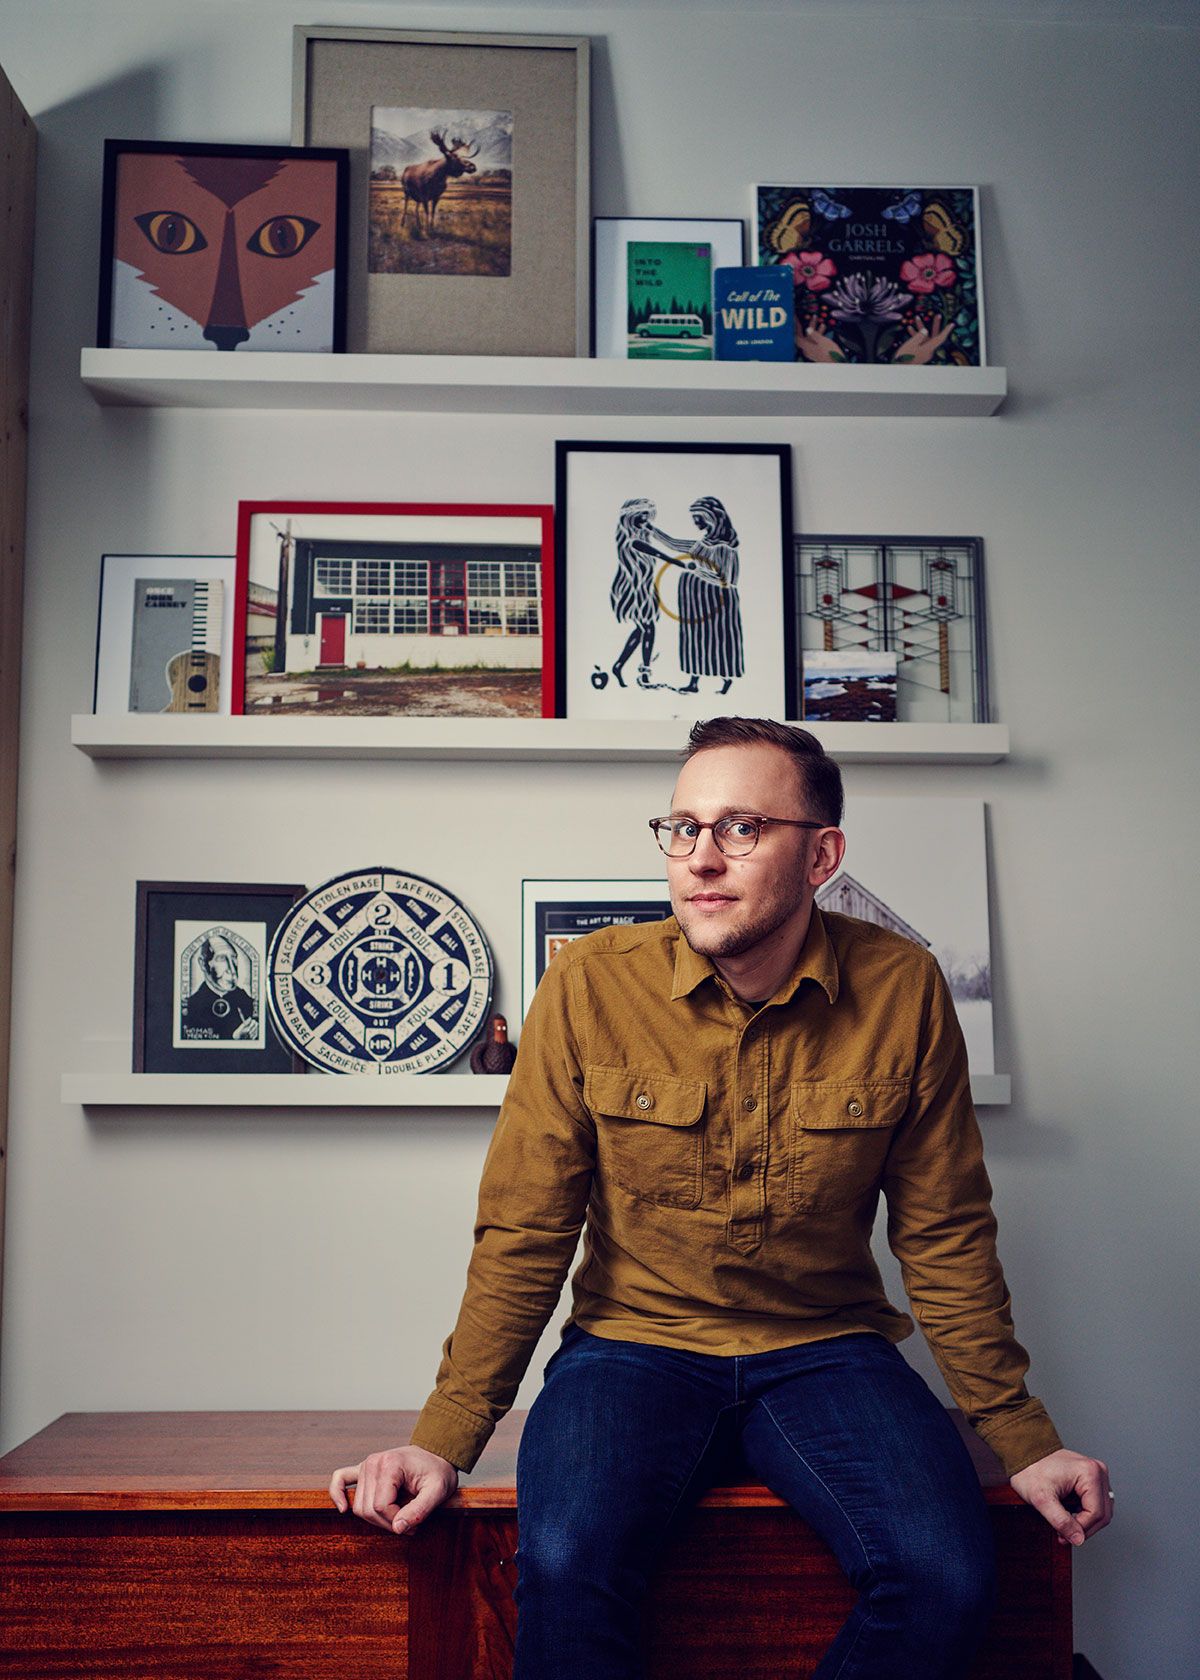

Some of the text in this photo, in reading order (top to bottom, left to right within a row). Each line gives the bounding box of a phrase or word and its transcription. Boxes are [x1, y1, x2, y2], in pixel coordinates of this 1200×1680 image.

[845, 223, 887, 237] JOSH
[828, 239, 905, 253] GARRELS
[634, 258, 662, 266] INTO
[635, 268, 657, 276] THE
[635, 279, 663, 287] WILD
[727, 289, 781, 302] Call of The
[721, 306, 787, 330] WILD
[314, 878, 379, 909] STOLEN BASE
[395, 881, 443, 904] SAFE HIT
[374, 904, 391, 926] 2
[589, 916, 601, 924] ART
[281, 915, 309, 964] SACRIFICE
[329, 928, 355, 952] FOUL
[406, 926, 432, 951] FOUL
[451, 911, 485, 974] STOLEN BASE
[376, 957, 387, 968] H
[309, 965, 325, 985] 3
[362, 970, 372, 982] H
[390, 971, 400, 982] H
[443, 963, 457, 991] 1
[376, 983, 387, 994] H
[278, 976, 310, 1040] STOLEN BASE
[326, 999, 352, 1025] FOUL
[407, 1004, 432, 1027] FOUL
[457, 990, 484, 1037] SAFE HIT
[373, 1019, 389, 1027] OUT
[369, 1039, 391, 1051] HR
[316, 1046, 367, 1073] SACRIFICE
[385, 1044, 449, 1075] DOUBLE PLAY
